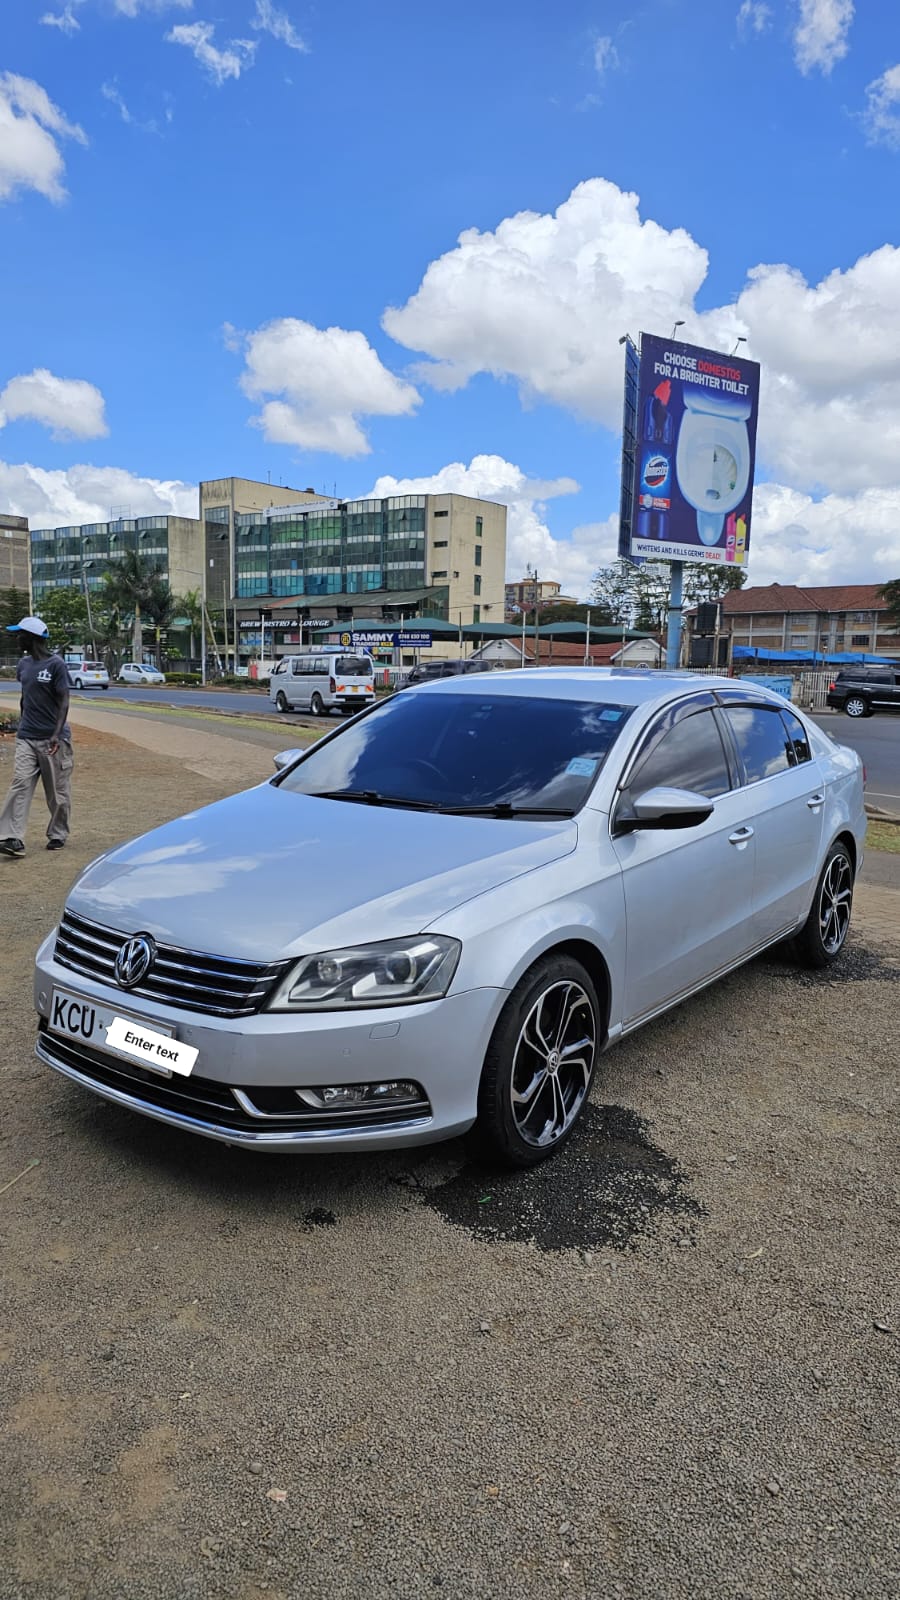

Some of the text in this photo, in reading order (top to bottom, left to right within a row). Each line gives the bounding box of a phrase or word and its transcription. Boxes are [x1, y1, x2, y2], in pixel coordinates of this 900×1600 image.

[664, 351, 741, 381] CHOOSE DOMESTOS
[654, 361, 749, 395] FOR A BRIGHTER TOILET
[637, 543, 661, 553] WHITENS
[661, 546, 672, 554] AND
[673, 548, 687, 556] KILLS
[688, 549, 704, 558] GERMS
[240, 620, 262, 628] BREW
[352, 633, 394, 642] SAMMY
[53, 996, 95, 1038] KCU
